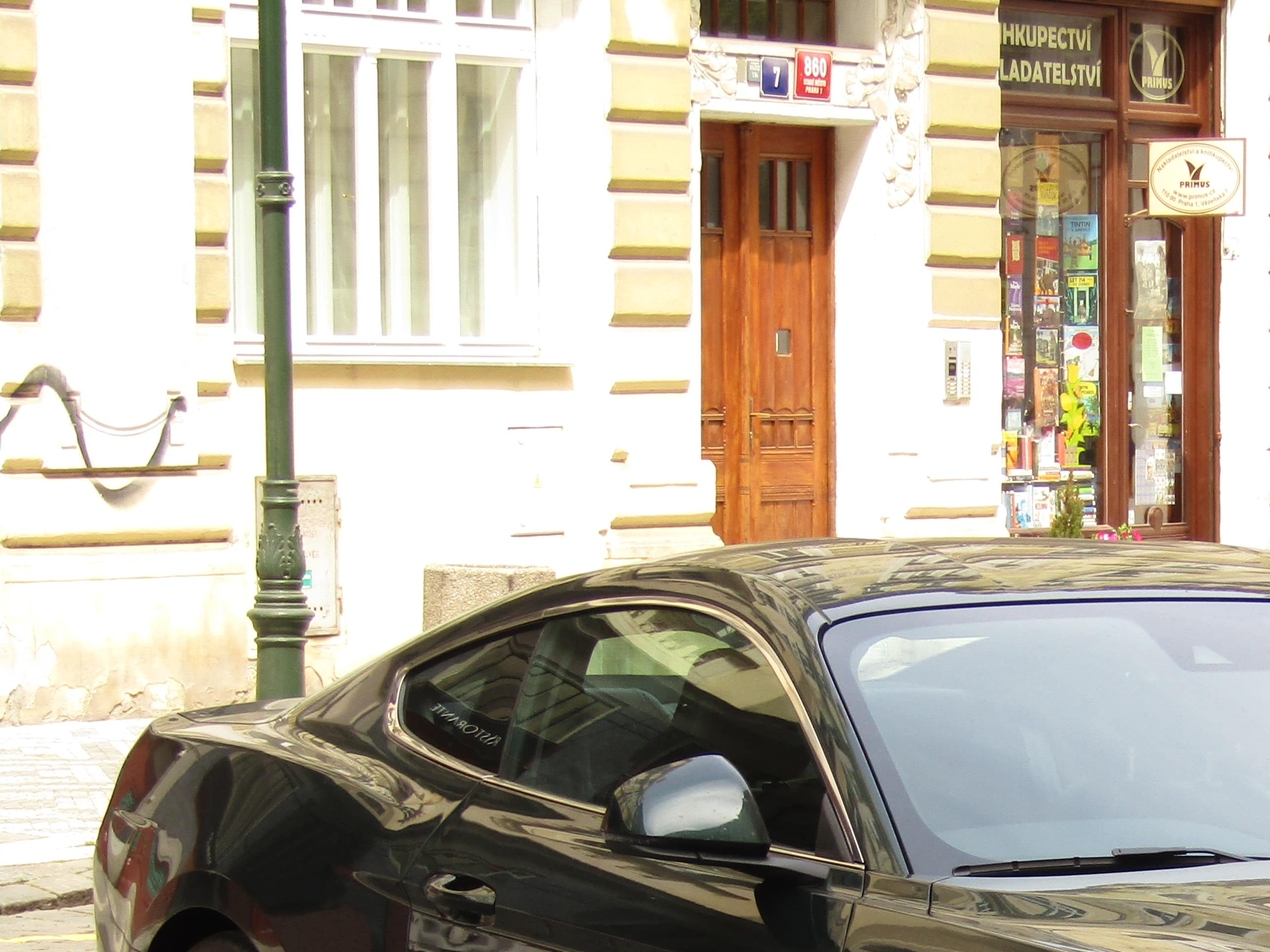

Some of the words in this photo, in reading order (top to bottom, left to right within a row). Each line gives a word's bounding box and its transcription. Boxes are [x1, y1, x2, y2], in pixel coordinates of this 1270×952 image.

[804, 55, 828, 78] 860
[772, 66, 781, 88] 7
[1142, 77, 1172, 89] PRIMUS
[1173, 188, 1216, 200] www.primus.cz
[1177, 198, 1194, 207] Praha
